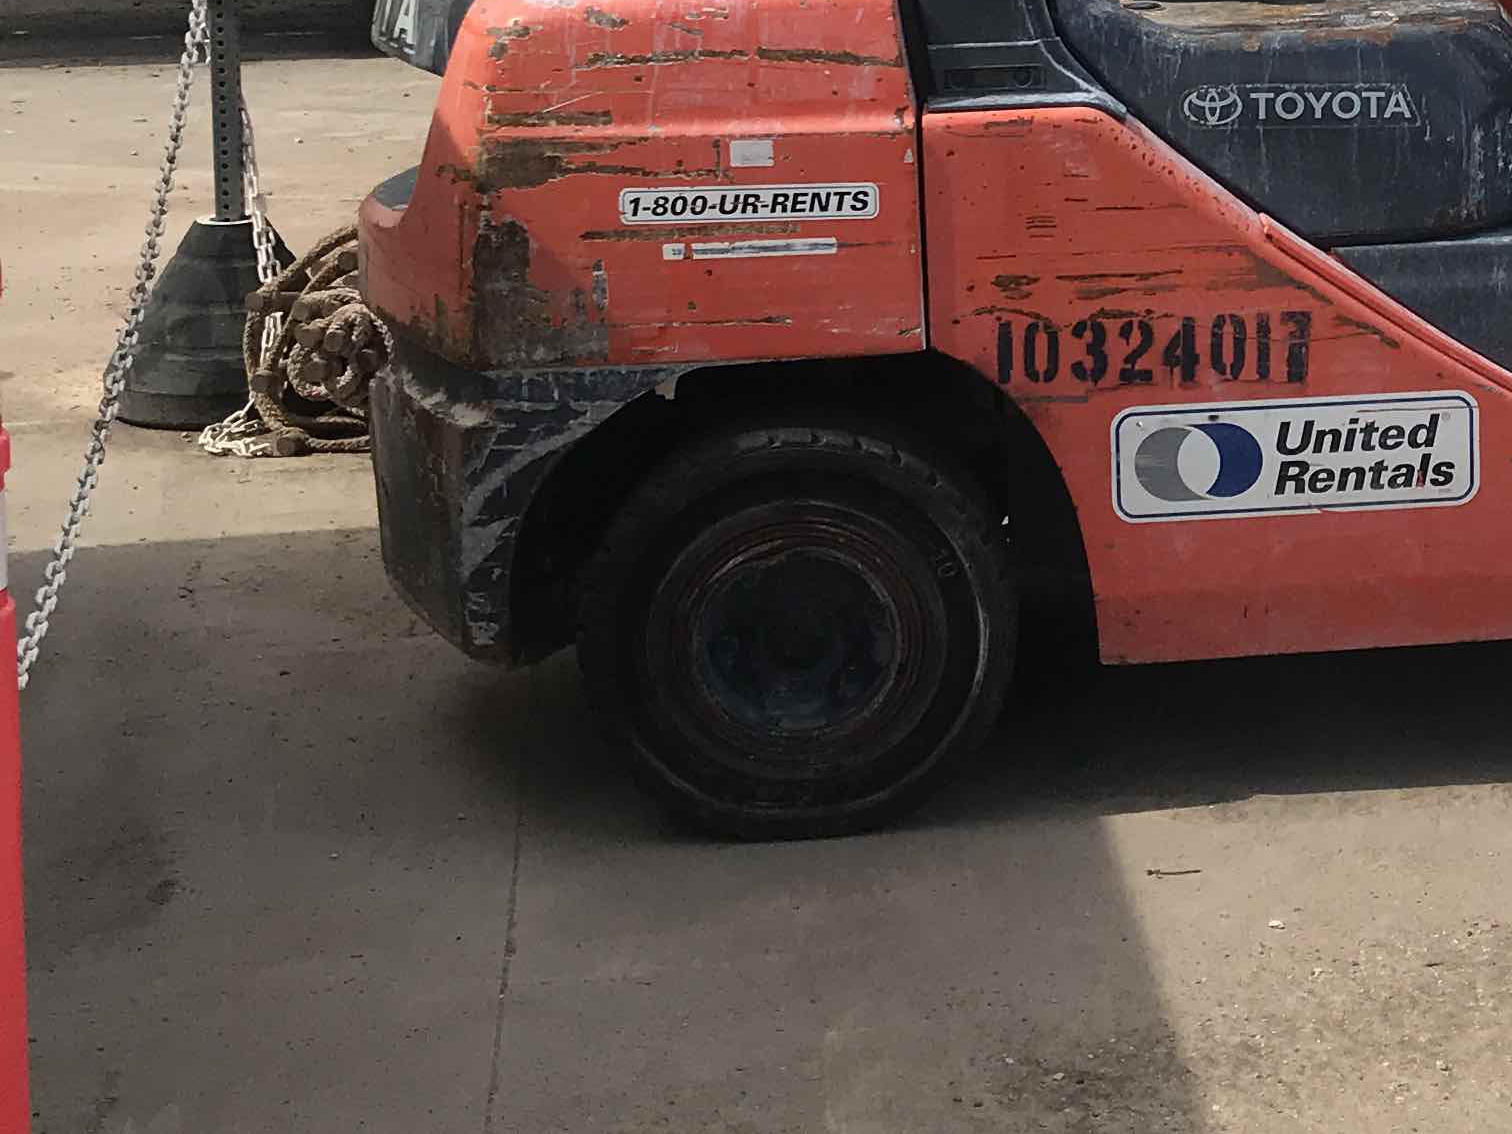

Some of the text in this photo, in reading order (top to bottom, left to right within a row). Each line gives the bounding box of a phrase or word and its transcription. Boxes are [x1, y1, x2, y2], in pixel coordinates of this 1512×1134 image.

[1249, 90, 1412, 120] TOYOTA
[628, 190, 870, 218] 1-800-UR-RENTS
[997, 310, 1312, 385] 10324017
[1275, 413, 1441, 456] United
[1274, 453, 1456, 496] Rentals
